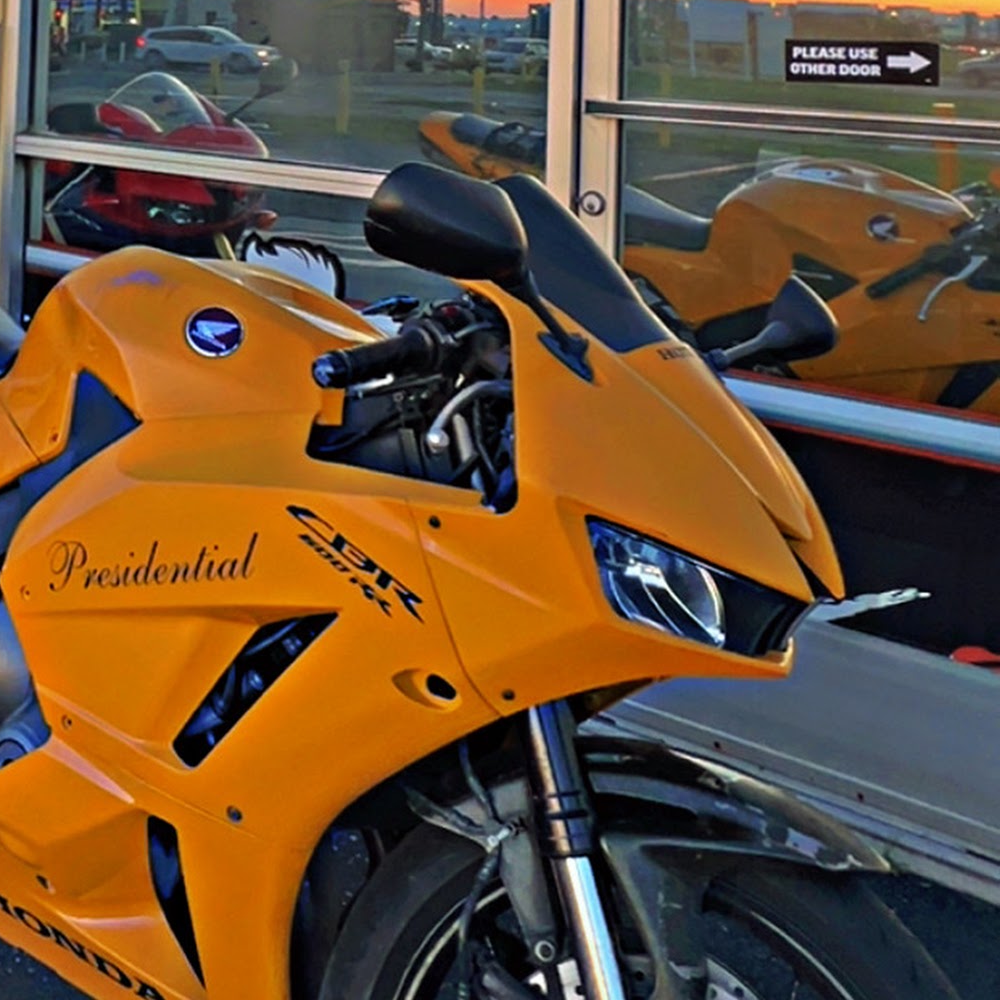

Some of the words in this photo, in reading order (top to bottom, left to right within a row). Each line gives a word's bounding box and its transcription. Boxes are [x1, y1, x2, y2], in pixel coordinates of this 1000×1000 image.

[789, 62, 836, 76] OTHER
[838, 63, 881, 77] DOOR
[791, 46, 846, 60] PLEASE
[849, 47, 879, 60] USE
[47, 531, 258, 593] Presidential
[285, 504, 425, 624] CBR
